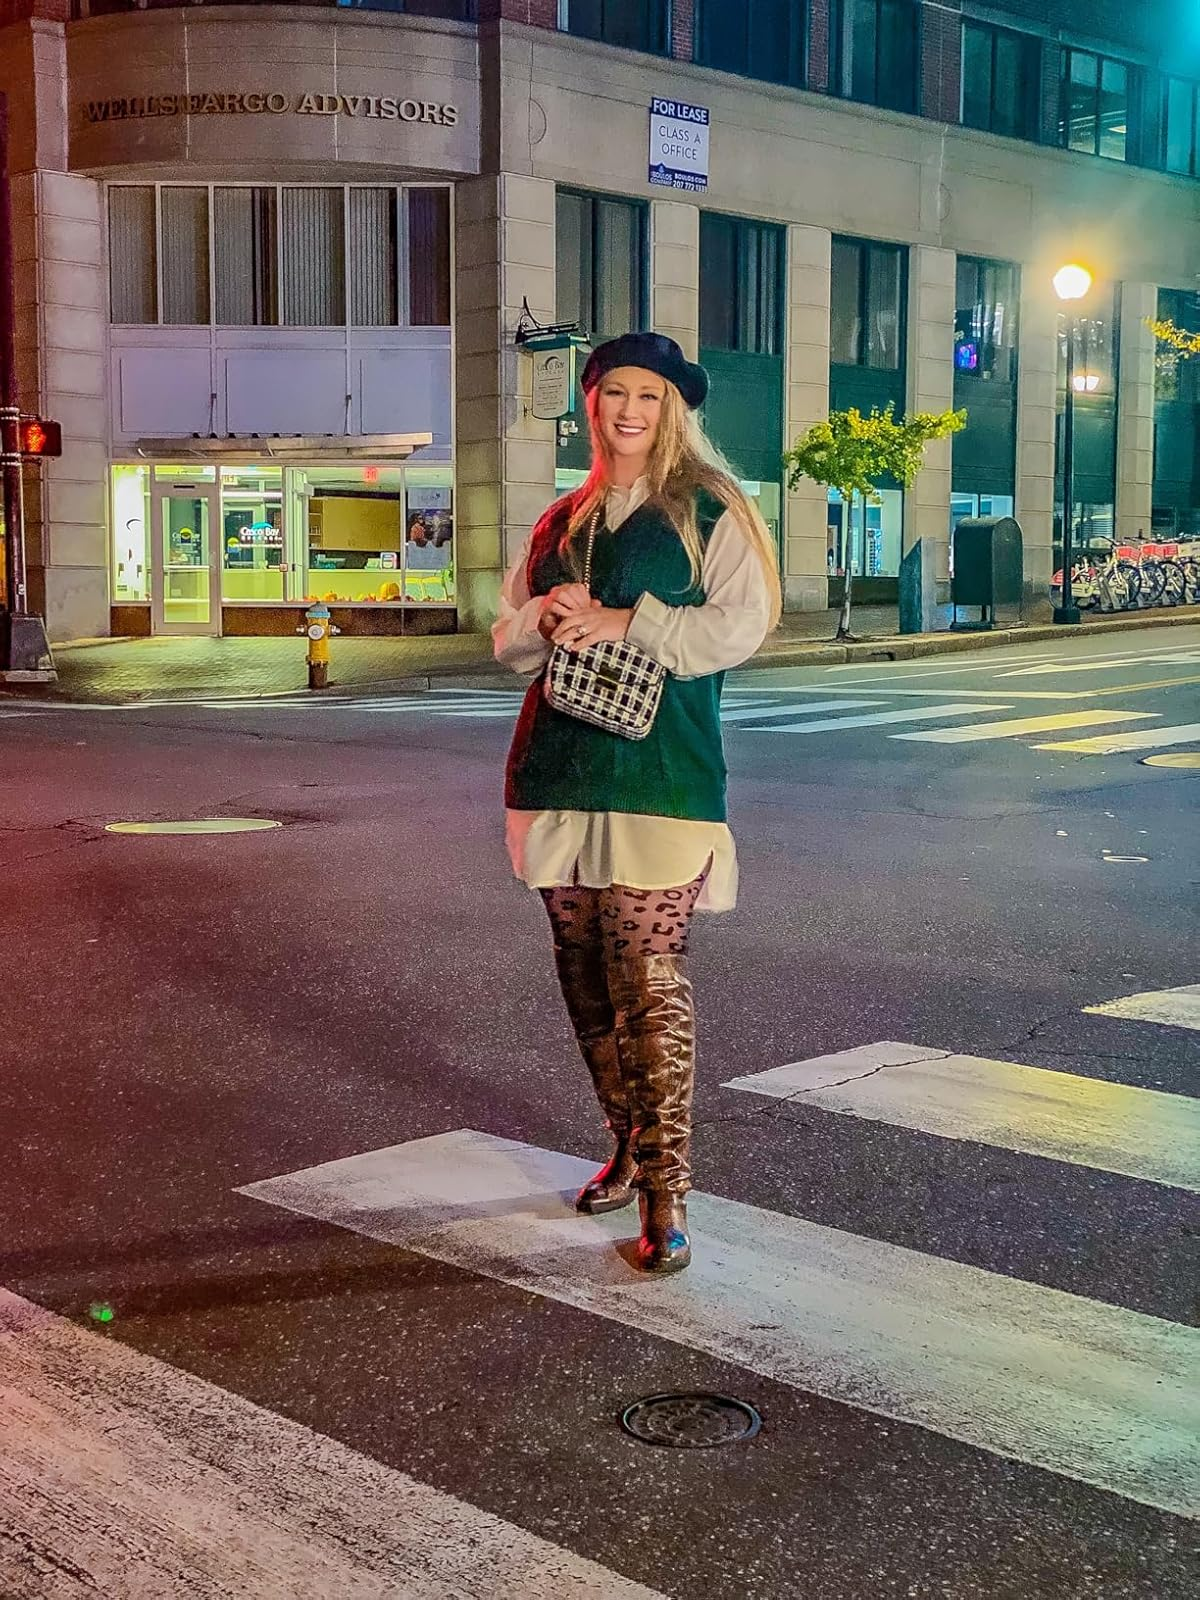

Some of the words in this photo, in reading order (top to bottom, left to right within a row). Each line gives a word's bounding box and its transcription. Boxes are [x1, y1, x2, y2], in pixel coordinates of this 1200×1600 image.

[87, 95, 178, 122] WELLS
[182, 92, 290, 115] FARGO
[297, 93, 459, 127] ADVISORS
[653, 99, 675, 115] FOR
[677, 105, 707, 123] LEASE
[658, 125, 690, 141] CLASS
[693, 132, 701, 144] A
[661, 143, 697, 160] OFFICE
[672, 180, 684, 189] 207
[685, 182, 695, 191] 772
[265, 526, 280, 537] Bay
